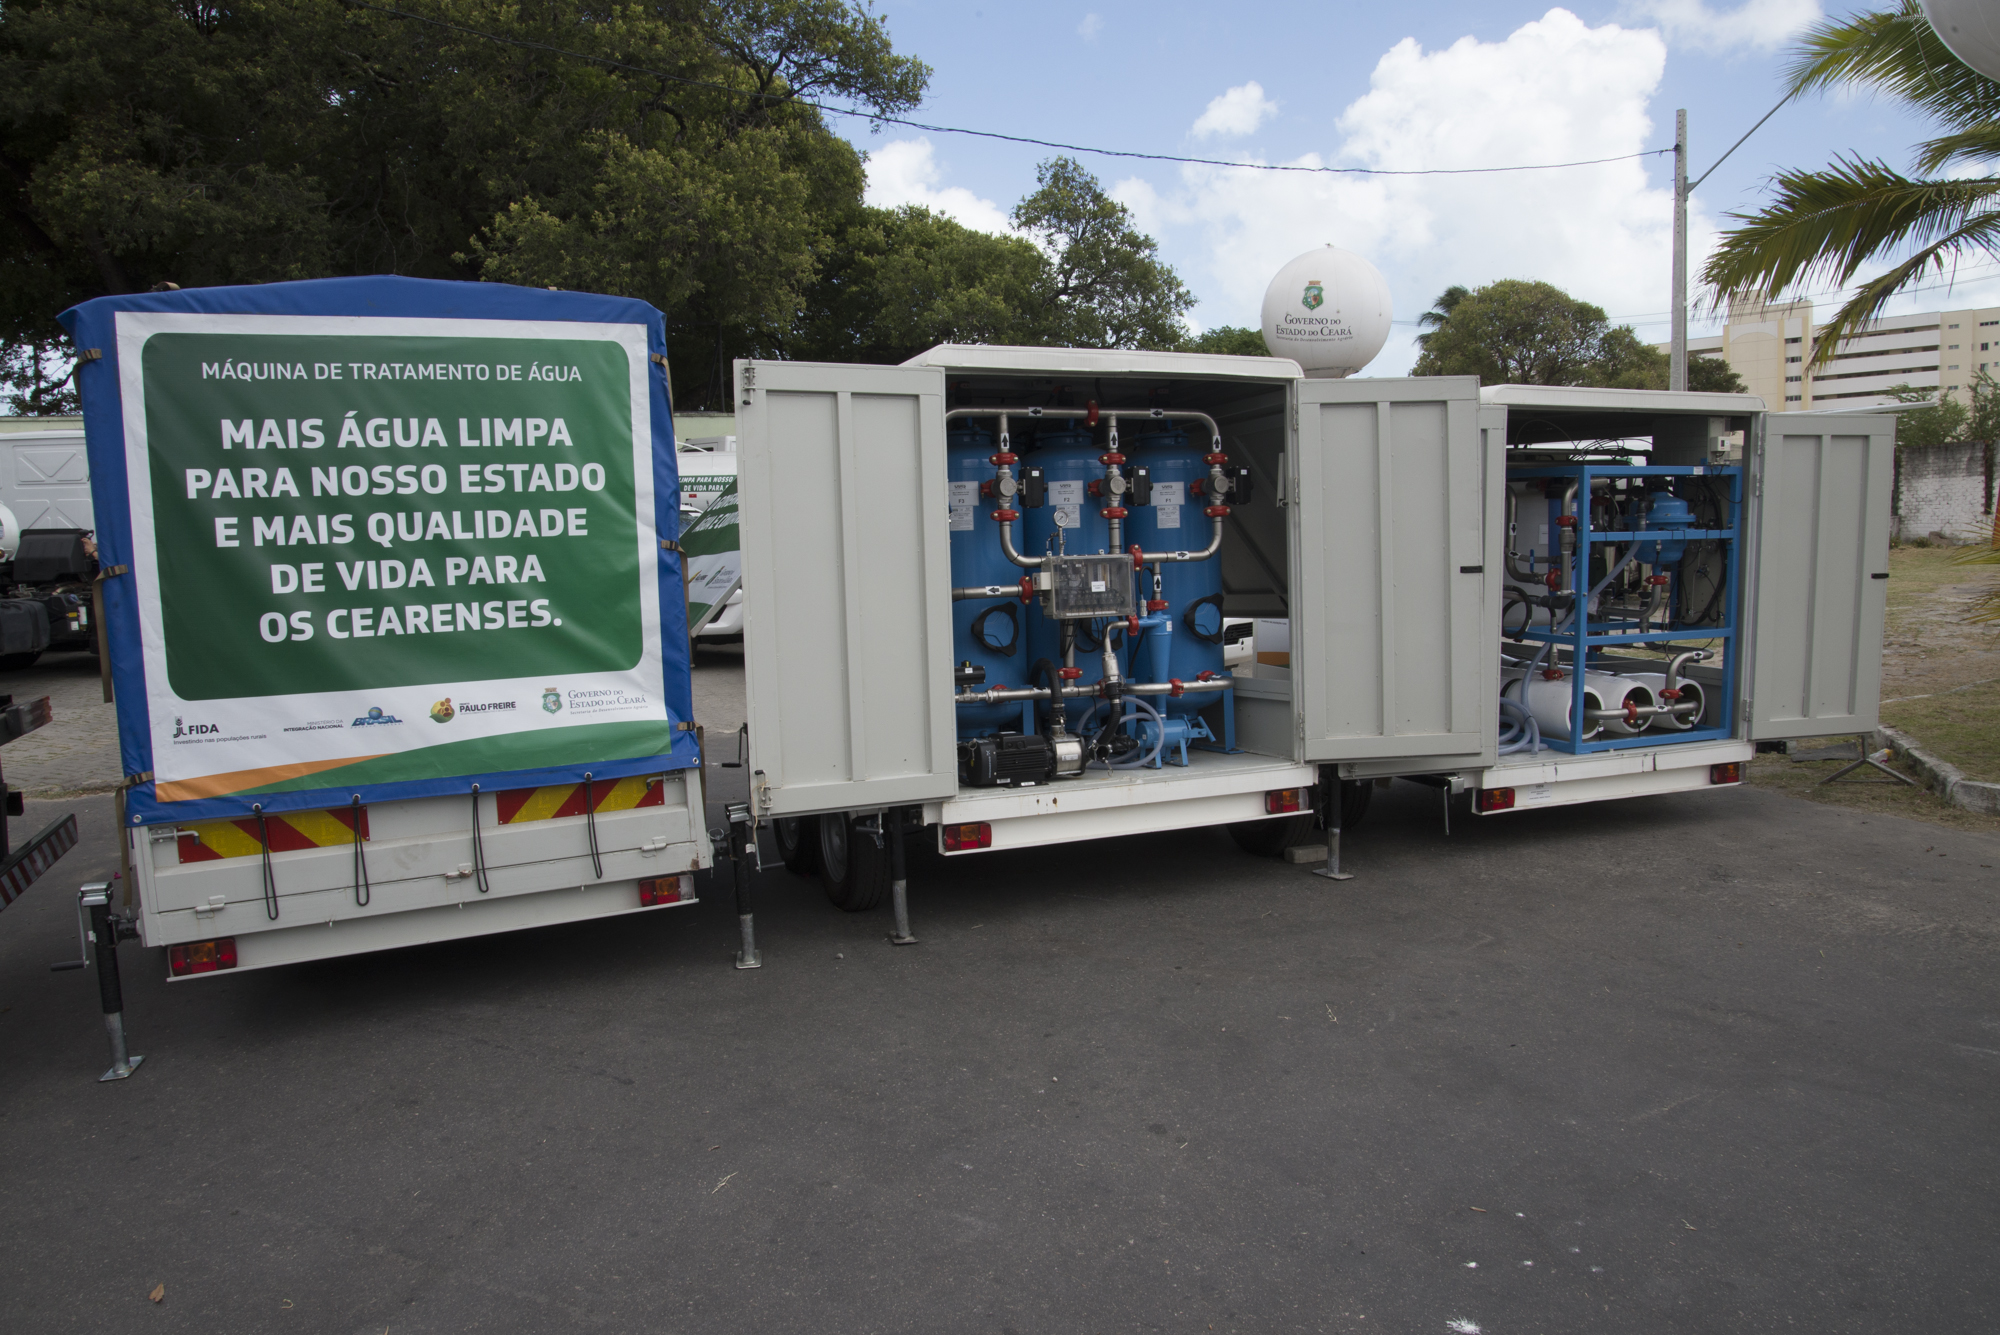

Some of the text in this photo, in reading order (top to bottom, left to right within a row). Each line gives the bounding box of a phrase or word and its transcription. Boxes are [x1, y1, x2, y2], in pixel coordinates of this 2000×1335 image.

[1284, 314, 1328, 325] GOVERNO
[1276, 324, 1306, 336] ESTADO
[1320, 326, 1352, 336] CEARÁ
[202, 359, 582, 381] MÁQUINA DE TRATAMENTO DE ÁGUA
[221, 411, 573, 449] MAIS ÁGUA LIMPA
[186, 463, 605, 498] PARA NOSSO ESTADO
[215, 508, 587, 547] E MAIS QUALIDADE
[271, 555, 546, 594] DE VIDA PARA
[260, 599, 562, 642] OS CEARENSES.
[568, 689, 612, 699] GOVERNO
[459, 704, 487, 713] PAULO
[487, 701, 517, 710] FREIRE
[569, 699, 604, 709] ESTADO
[617, 694, 647, 705] CEARÁ
[351, 714, 403, 726] BRASIL
[188, 723, 219, 735] FIDA
[173, 737, 204, 745] Investindo
[216, 735, 250, 744] populações
